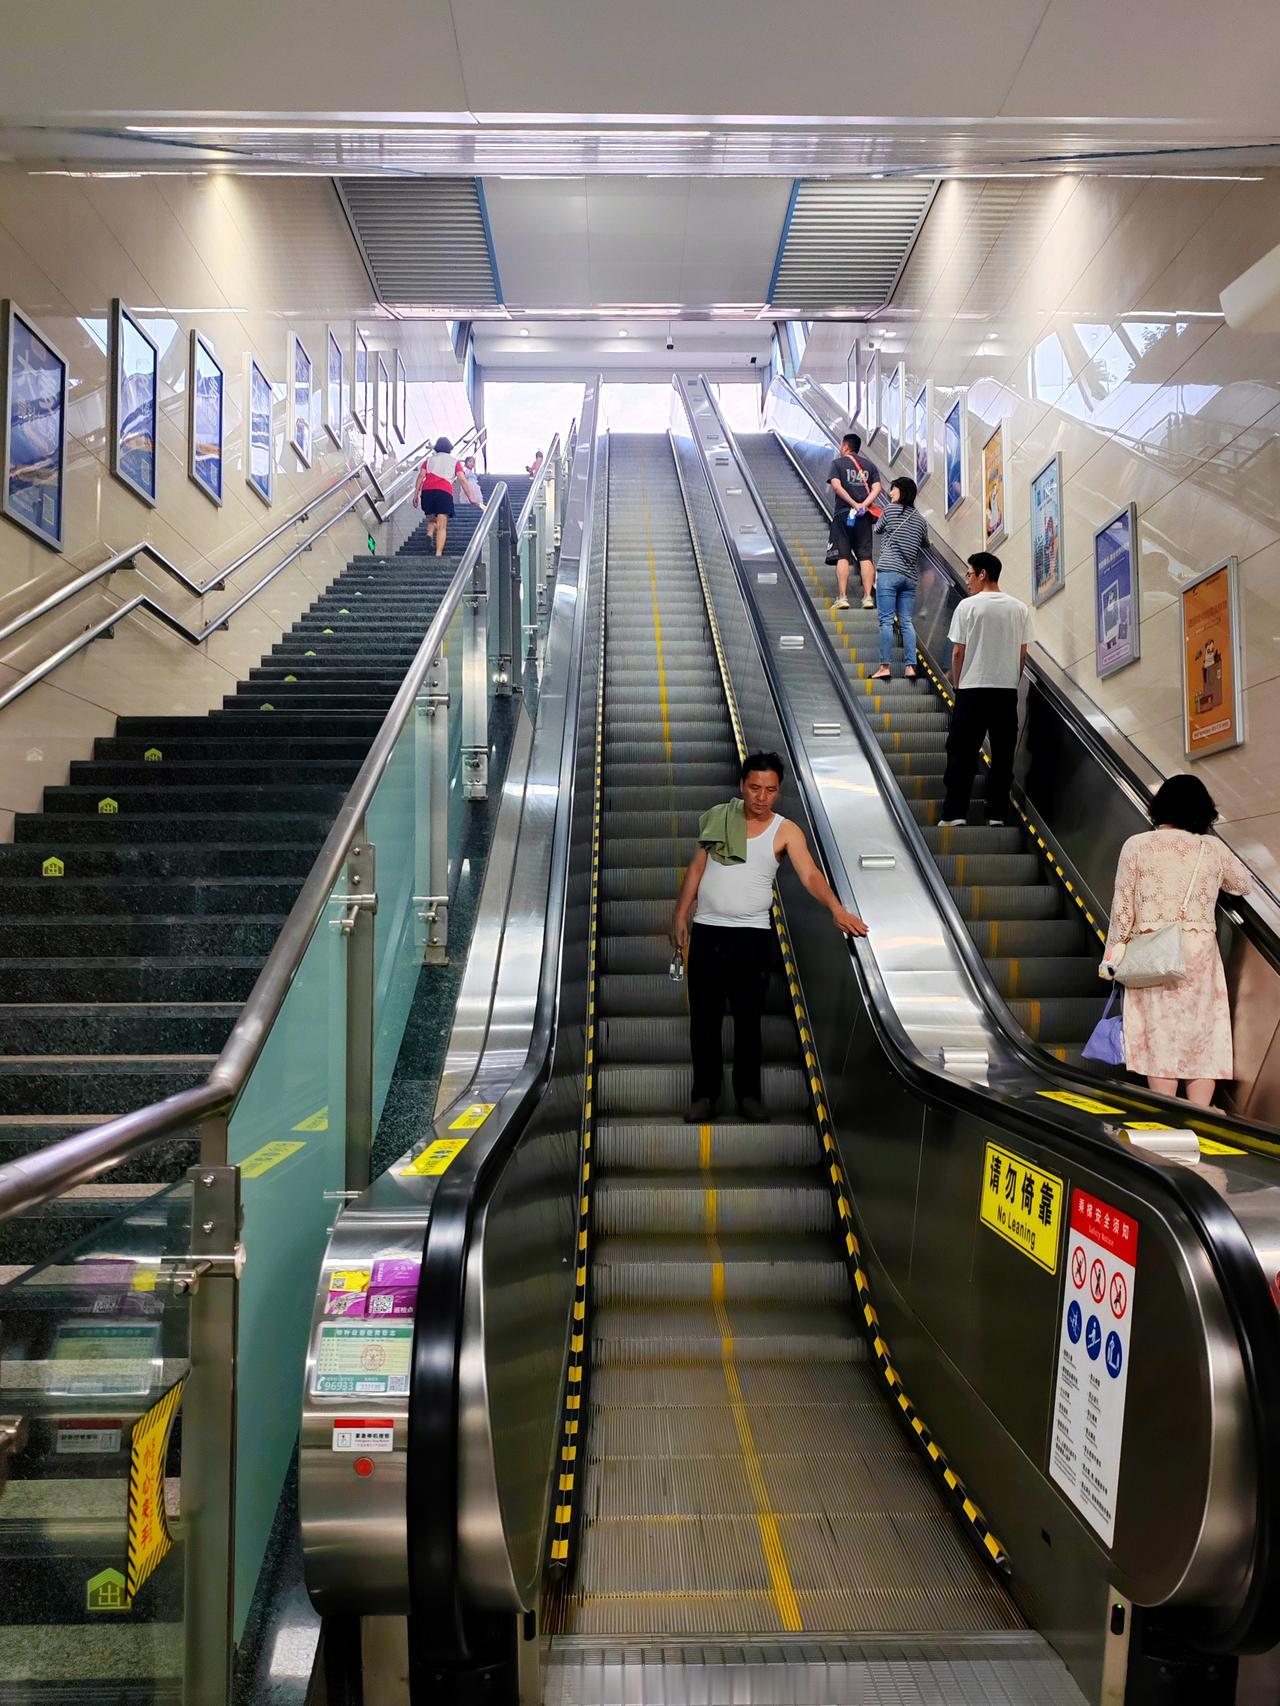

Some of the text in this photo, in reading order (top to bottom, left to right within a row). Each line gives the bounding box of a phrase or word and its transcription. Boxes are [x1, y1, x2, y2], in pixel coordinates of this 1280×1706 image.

[989, 1154, 1054, 1227] 请勿倚靠
[997, 1204, 1036, 1251] No Leaning
